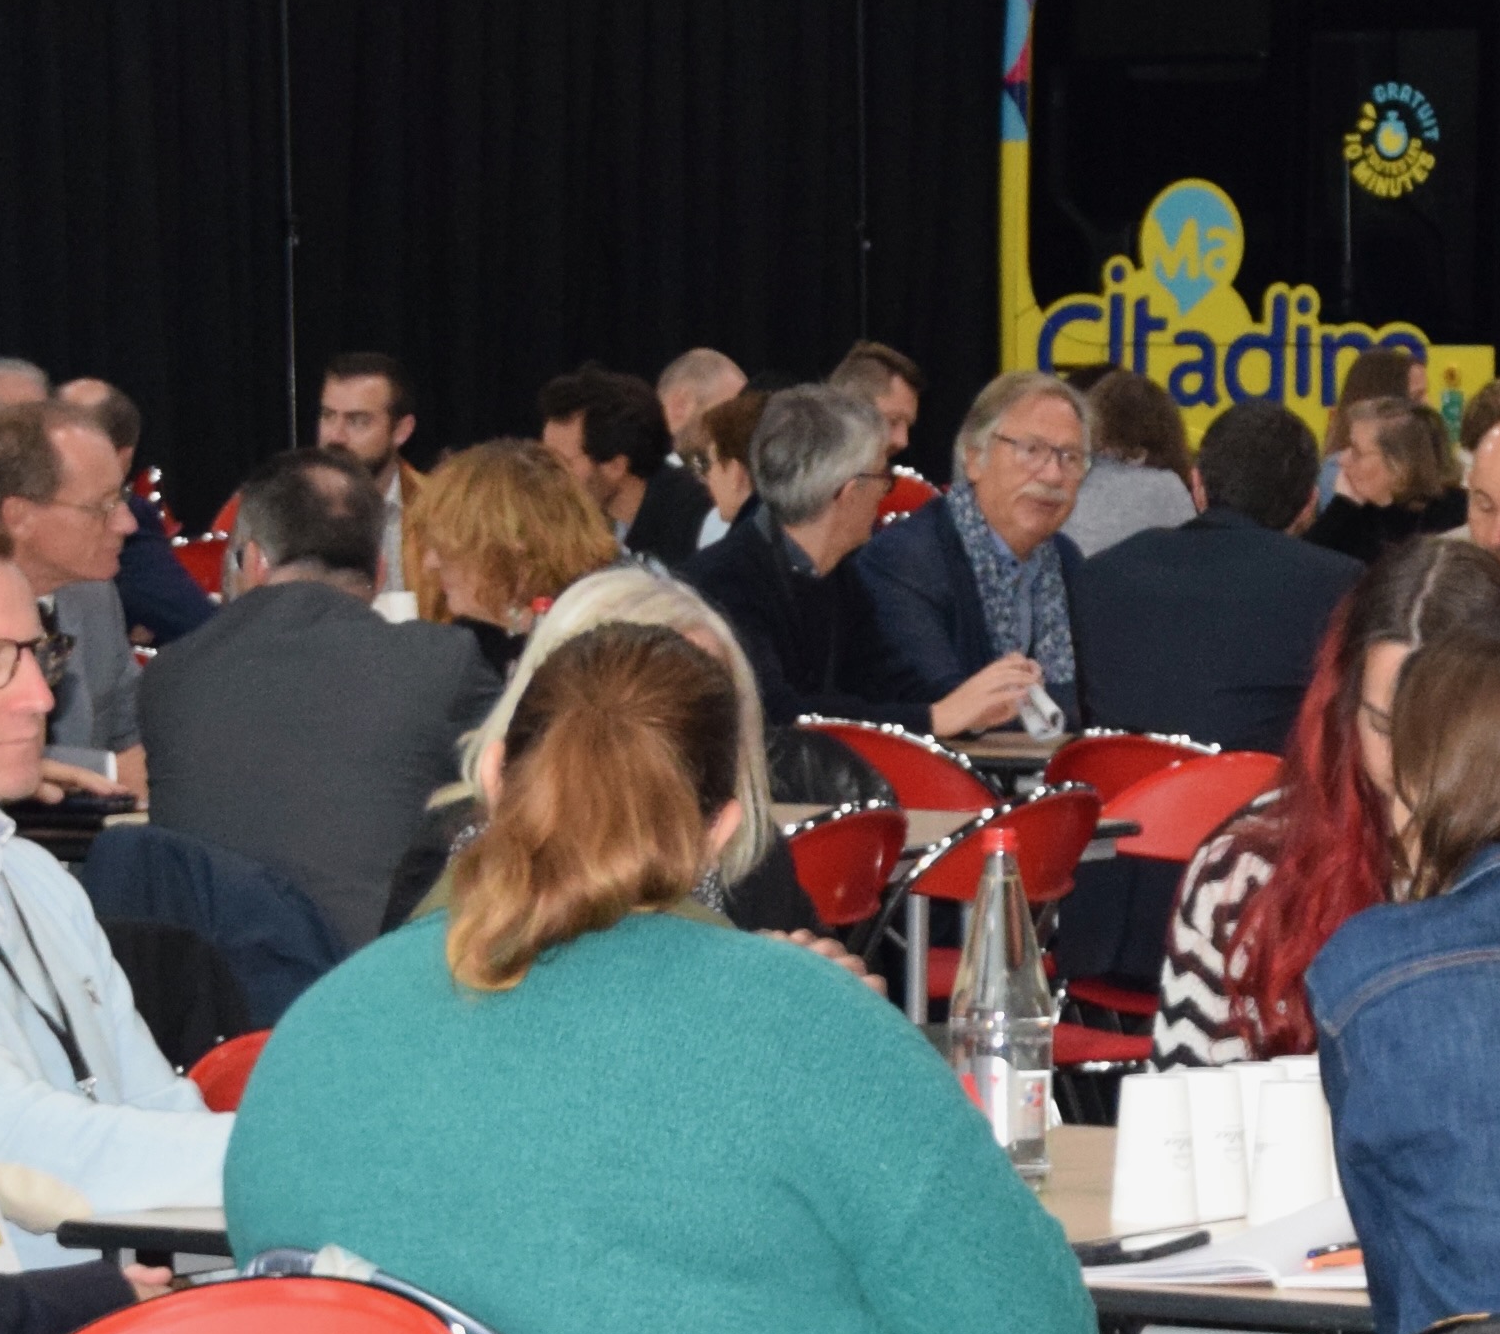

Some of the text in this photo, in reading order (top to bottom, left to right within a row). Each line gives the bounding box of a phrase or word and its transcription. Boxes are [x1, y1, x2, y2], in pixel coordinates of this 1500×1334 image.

[1372, 81, 1440, 141] GRATUIT
[1344, 133, 1436, 198] 10 MINUTES
[1148, 217, 1235, 280] Ma
